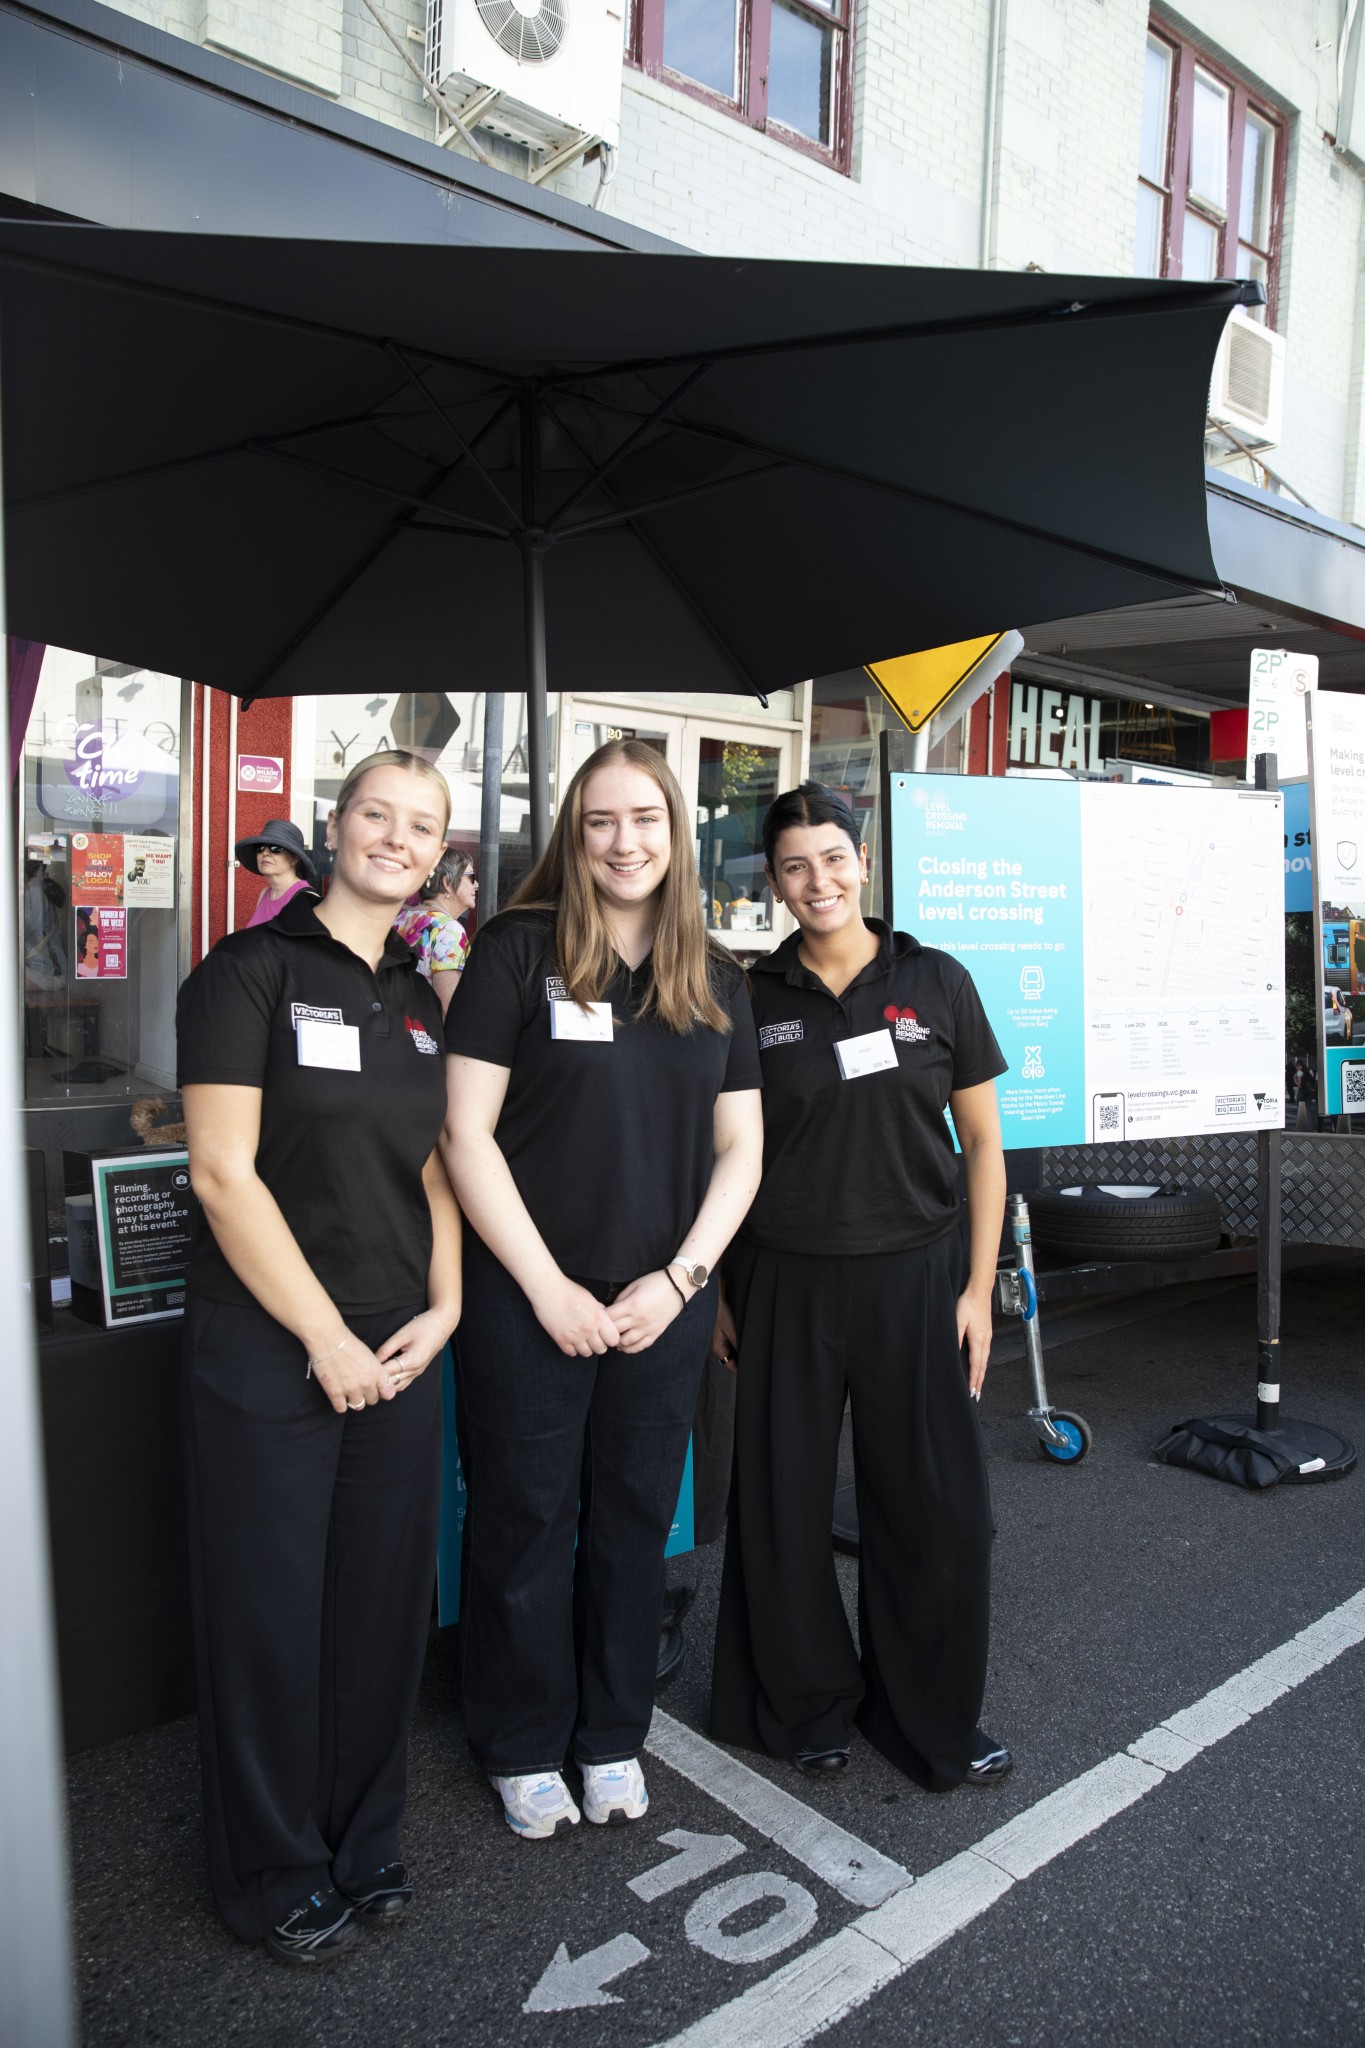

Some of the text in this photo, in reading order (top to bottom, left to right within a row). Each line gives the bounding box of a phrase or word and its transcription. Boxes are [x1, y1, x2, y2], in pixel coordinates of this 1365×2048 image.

[1256, 652, 1282, 673] 2P
[1252, 710, 1279, 731] 2P
[608, 728, 622, 740] 20
[1009, 683, 1104, 774] HEAL
[1330, 748, 1364, 764] Making
[76, 760, 139, 789] time
[1330, 765, 1354, 776] level
[925, 802, 951, 812] LEVEL
[925, 812, 968, 821] CROSSING
[925, 821, 965, 830] REMOVAL
[918, 856, 1023, 880] Closing the
[918, 879, 1067, 898] Anderson Street
[919, 903, 1044, 925] level crossing
[940, 941, 956, 950] this
[958, 942, 978, 951] level
[980, 942, 1015, 952] crossing
[1017, 942, 1042, 950] needs
[1054, 943, 1065, 952] go
[550, 989, 566, 997] BIG
[294, 1006, 340, 1020] VICTORIA'S
[896, 1018, 918, 1026] LEVEL
[762, 1022, 800, 1037] VICTORIA'S
[896, 1024, 930, 1035] CROSSING
[896, 1030, 927, 1041] REMOVAL
[777, 1032, 801, 1042] BUILD
[1128, 1088, 1198, 1098] levelcrossings.vic.gov.au
[115, 1190, 160, 1204] recording
[116, 1200, 175, 1216] photography
[117, 1208, 188, 1227] may take place
[118, 1219, 179, 1234] at this event.
[625, 1828, 819, 1965] 10
